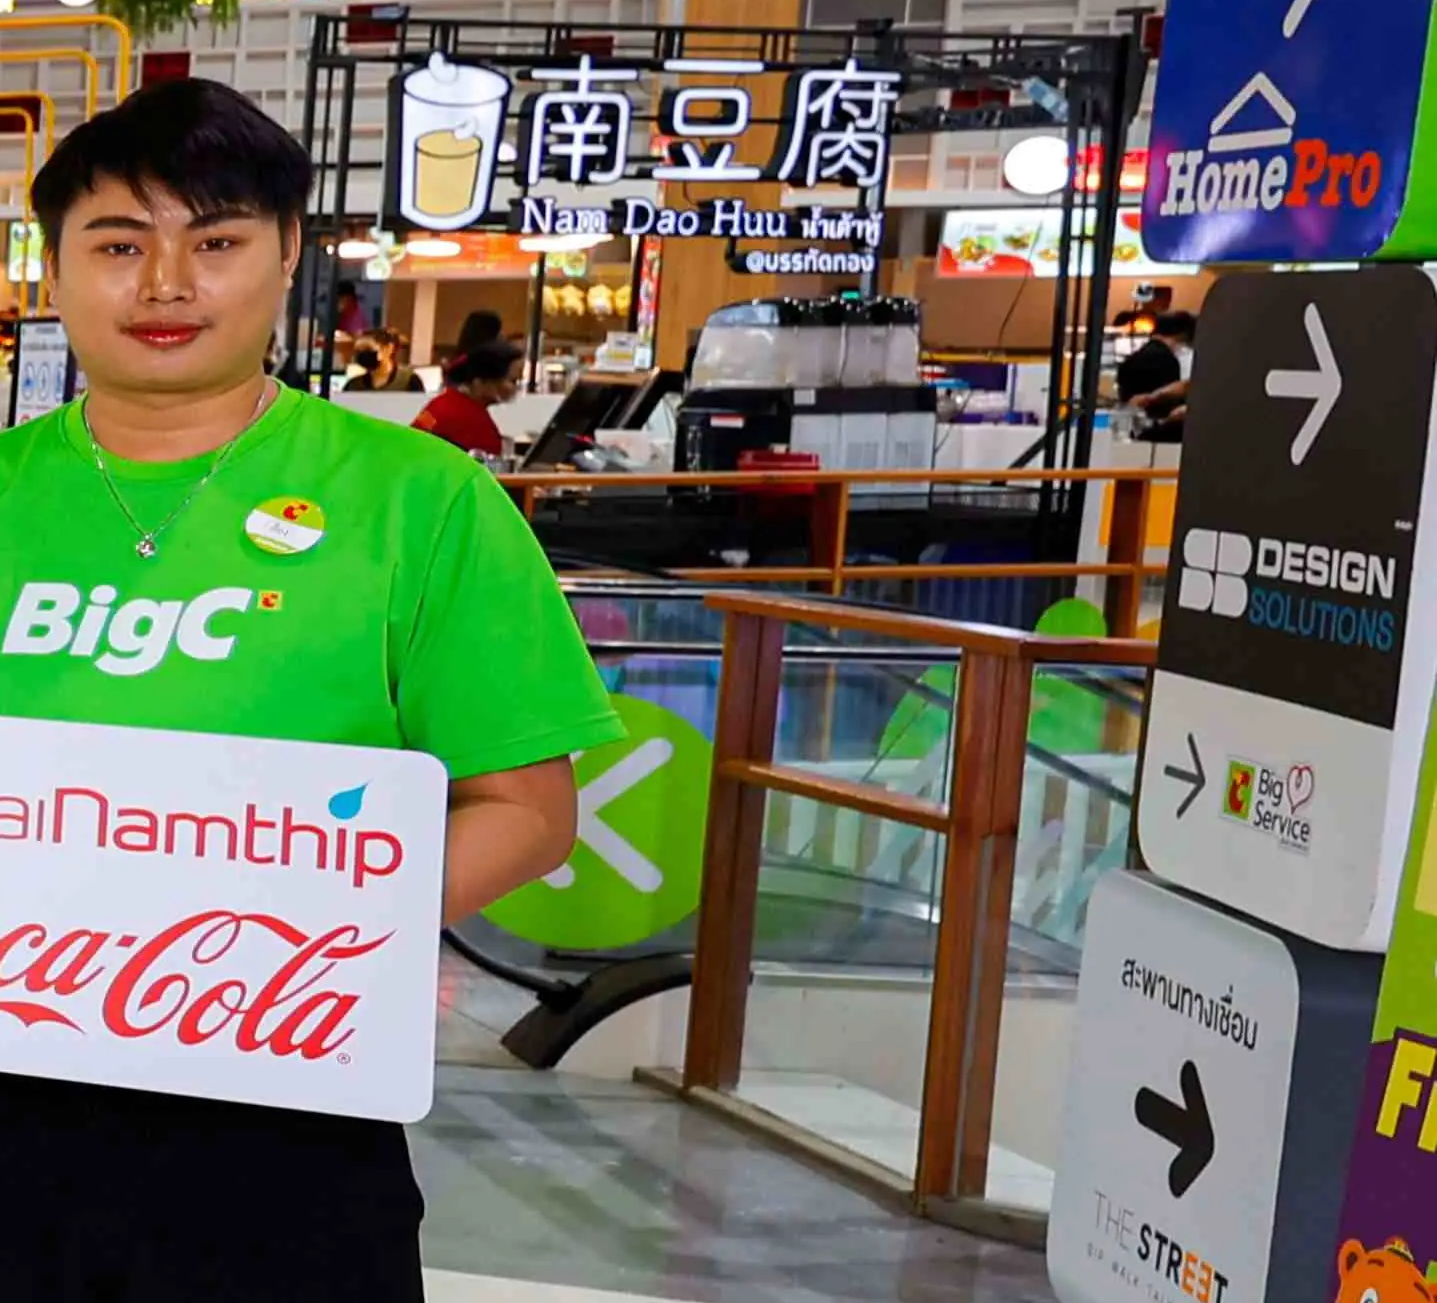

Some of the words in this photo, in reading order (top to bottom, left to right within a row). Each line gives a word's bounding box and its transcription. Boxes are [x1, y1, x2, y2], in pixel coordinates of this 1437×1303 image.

[526, 54, 902, 188] 南豆腐
[521, 198, 608, 235] Nam
[622, 198, 699, 236] Dao
[711, 199, 787, 237] Huu
[1256, 538, 1396, 599] DESIGN
[1249, 587, 1395, 652] SOLUTIONS
[1258, 768, 1283, 807] Big
[1253, 800, 1311, 843] Service
[1121, 958, 1258, 1050] สะพานทางเชื่อม
[1094, 1190, 1135, 1251] THE
